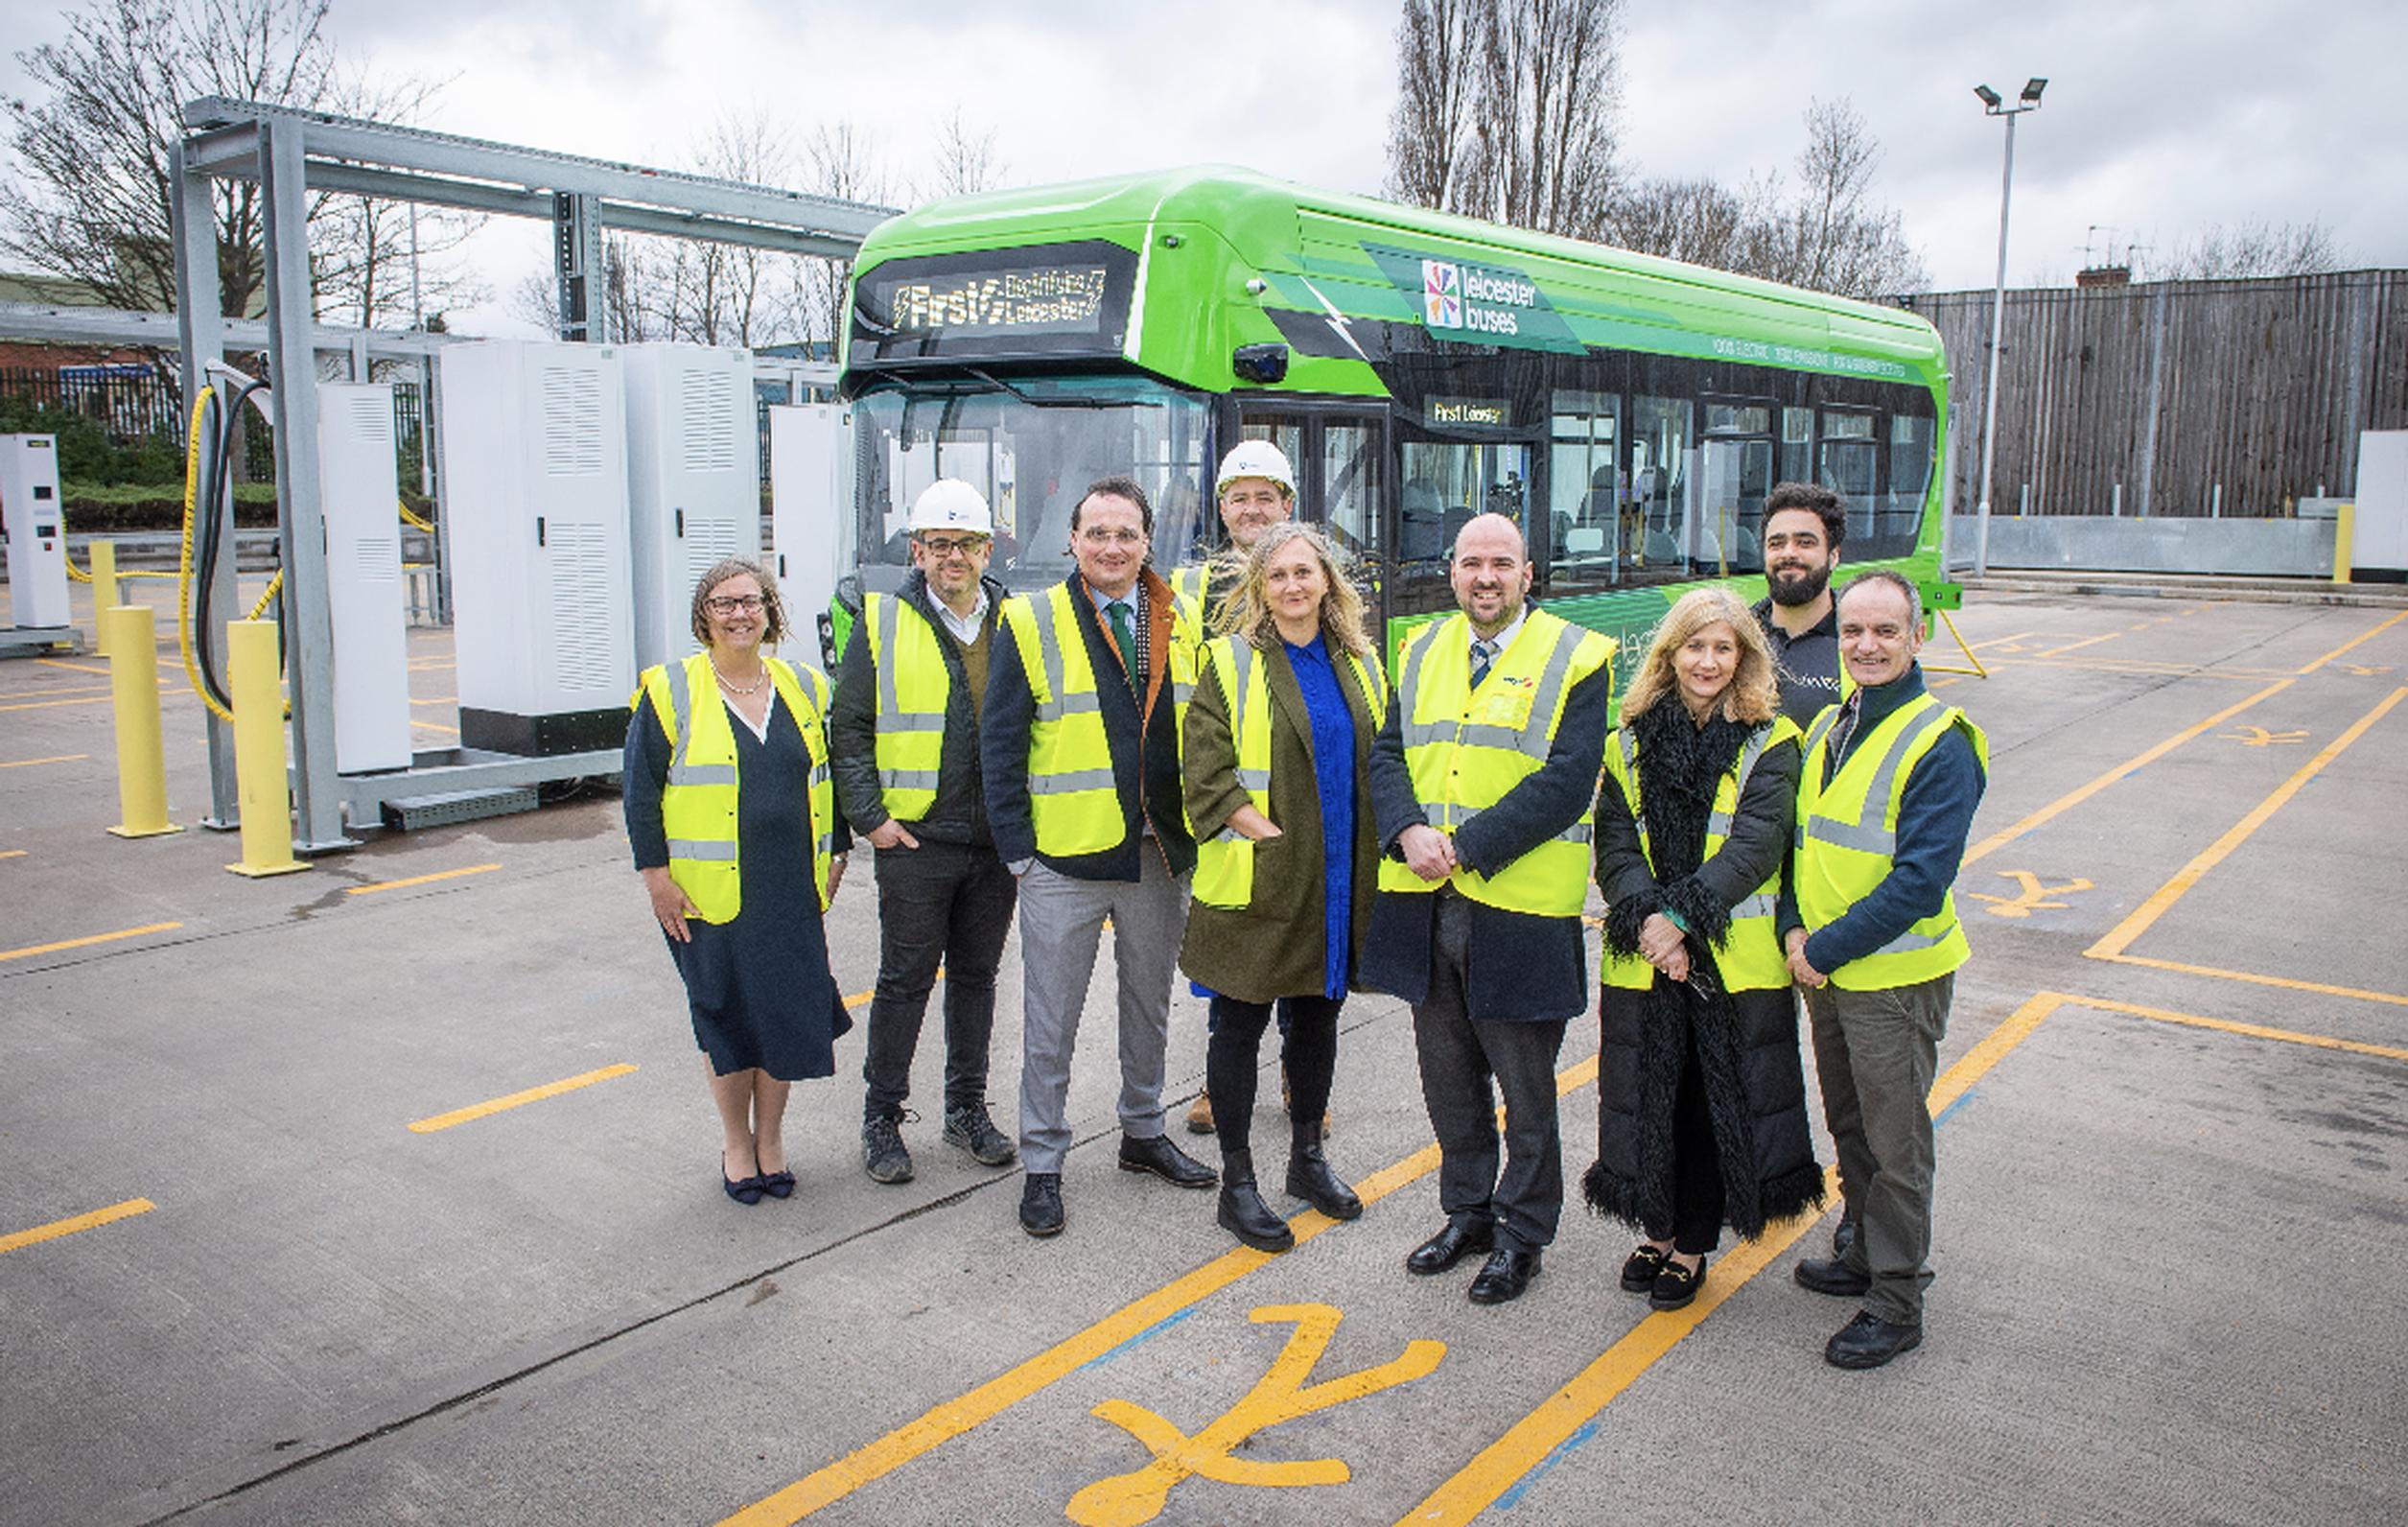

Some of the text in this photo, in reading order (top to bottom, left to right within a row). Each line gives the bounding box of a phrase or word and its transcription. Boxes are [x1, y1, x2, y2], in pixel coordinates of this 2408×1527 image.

[1461, 266, 1535, 307] leicester
[1465, 299, 1518, 336] buses
[1435, 402, 1461, 422] First
